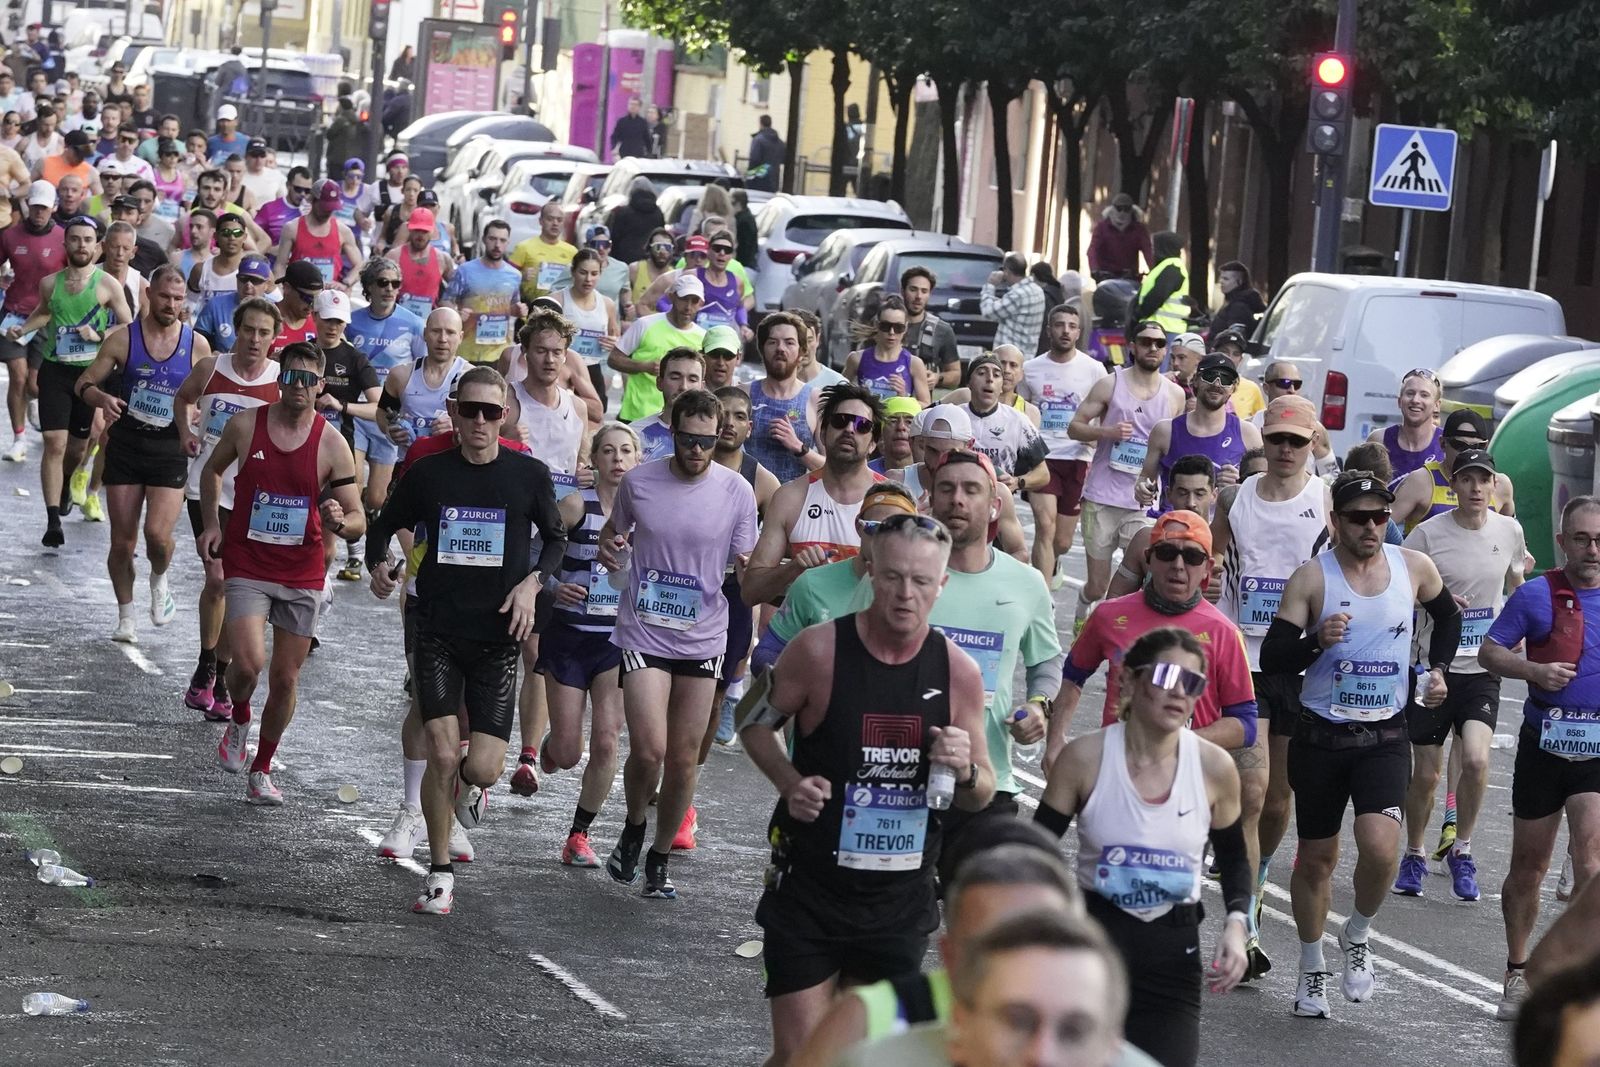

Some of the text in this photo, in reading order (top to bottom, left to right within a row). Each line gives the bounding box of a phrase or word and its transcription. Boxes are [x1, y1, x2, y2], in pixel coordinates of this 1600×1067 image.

[69, 344, 85, 353] BEN
[133, 400, 169, 417] ARNAUD
[551, 474, 574, 484] RICH
[272, 497, 304, 506] ZURICH
[271, 511, 289, 520] 6303
[462, 510, 498, 520] ZURICH
[265, 521, 290, 534] LUIS
[462, 527, 482, 537] 9032
[450, 538, 493, 553] PIERRE
[661, 574, 696, 587] ZURICH
[1262, 582, 1286, 591] ZURI
[590, 593, 619, 604] SOPHIE
[659, 590, 679, 602] 6491
[637, 598, 697, 619] ALBEROLA
[1463, 610, 1488, 620] URICH
[1462, 625, 1474, 633] 772
[950, 632, 994, 647] ZURICH
[1357, 664, 1393, 674] ZURICH
[1356, 682, 1377, 691] 6615
[1340, 691, 1390, 707] GERMAN
[1566, 728, 1586, 738] 8583
[861, 747, 921, 764] TREVOR
[856, 763, 920, 780] Michelob
[877, 793, 925, 807] ZURICH
[876, 821, 902, 831] 7611
[855, 832, 915, 851] TREVOR
[1131, 852, 1185, 868] ZURICH
